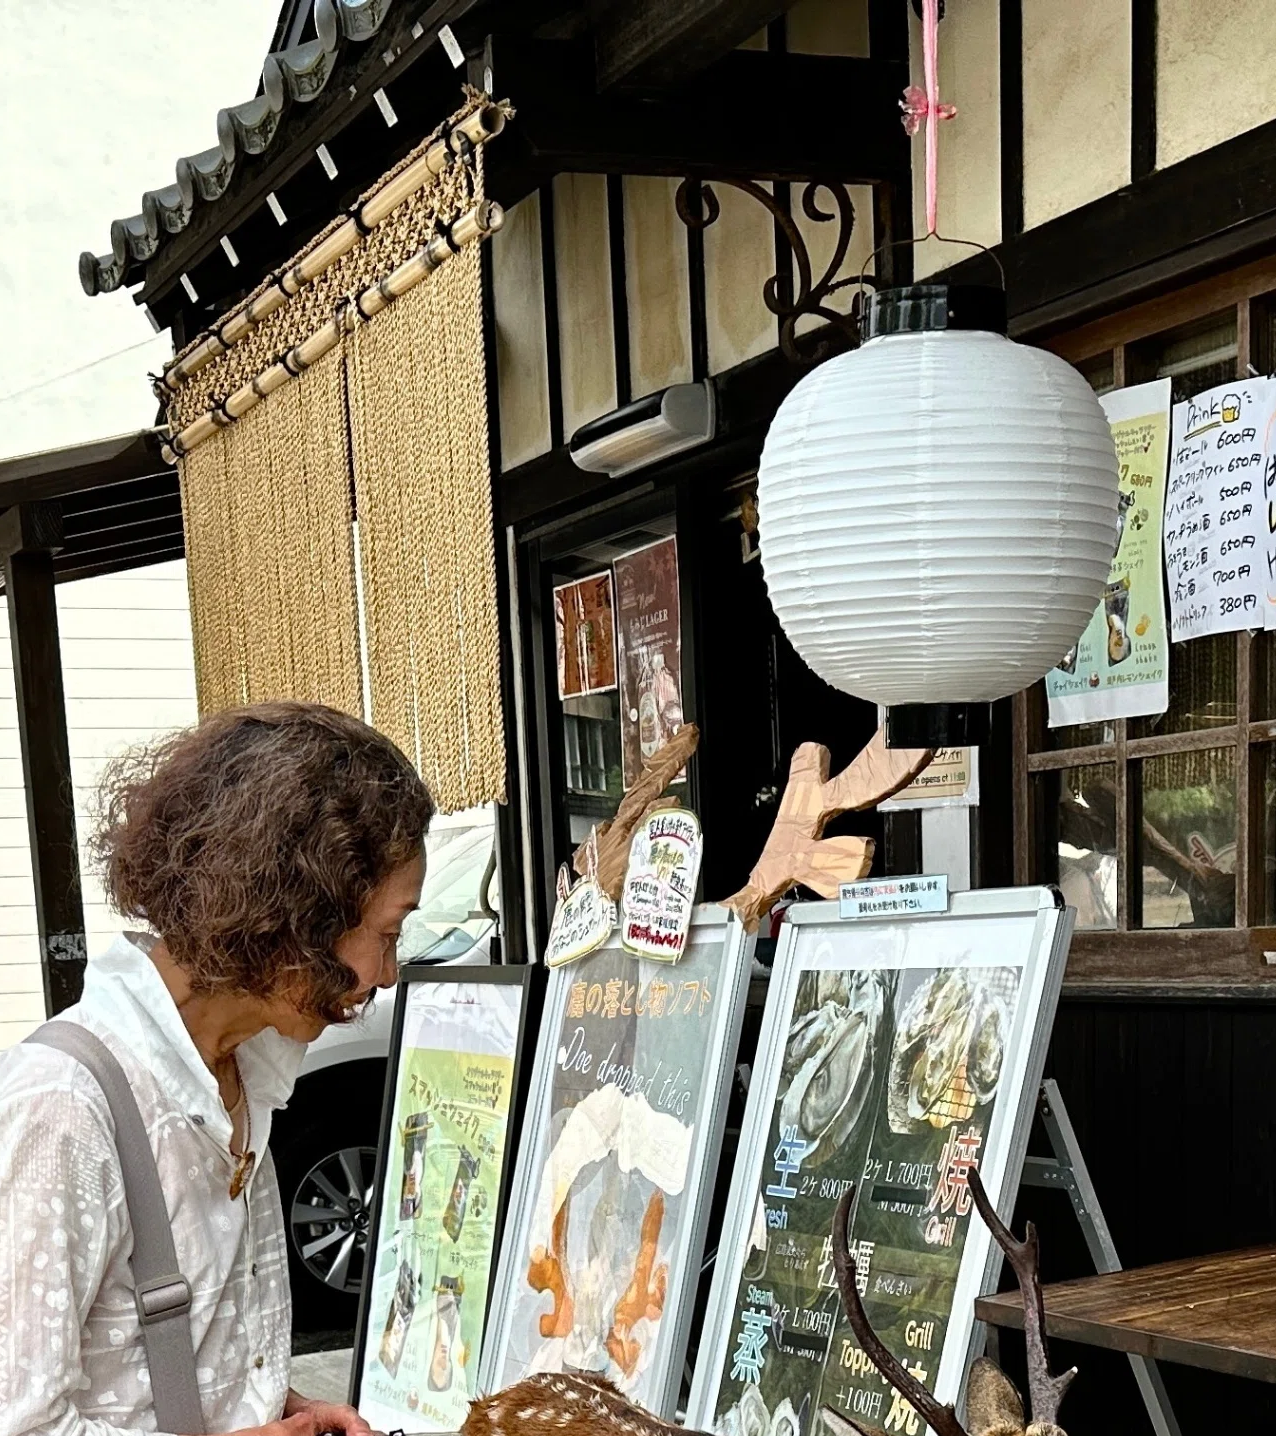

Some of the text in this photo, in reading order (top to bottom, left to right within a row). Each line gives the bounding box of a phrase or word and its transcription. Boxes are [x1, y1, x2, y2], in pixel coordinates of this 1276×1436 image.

[1187, 390, 1221, 432] Drink
[1217, 428, 1256, 451] 600円
[1228, 454, 1261, 474] 650円
[1220, 482, 1252, 502] 500円
[1220, 504, 1253, 526] 650円
[1220, 535, 1255, 556] 650円
[1213, 564, 1251, 586] 700円
[1219, 594, 1257, 616] 380円
[561, 1026, 592, 1074] Doe
[657, 1068, 691, 1116] this
[766, 1125, 807, 1199] 生
[897, 1162, 934, 1190] 700円
[929, 1125, 983, 1217] 焼
[925, 1216, 958, 1248] Grill
[802, 1308, 832, 1337] 700円
[905, 1319, 935, 1350] Grill
[730, 1307, 772, 1385] 蒸
